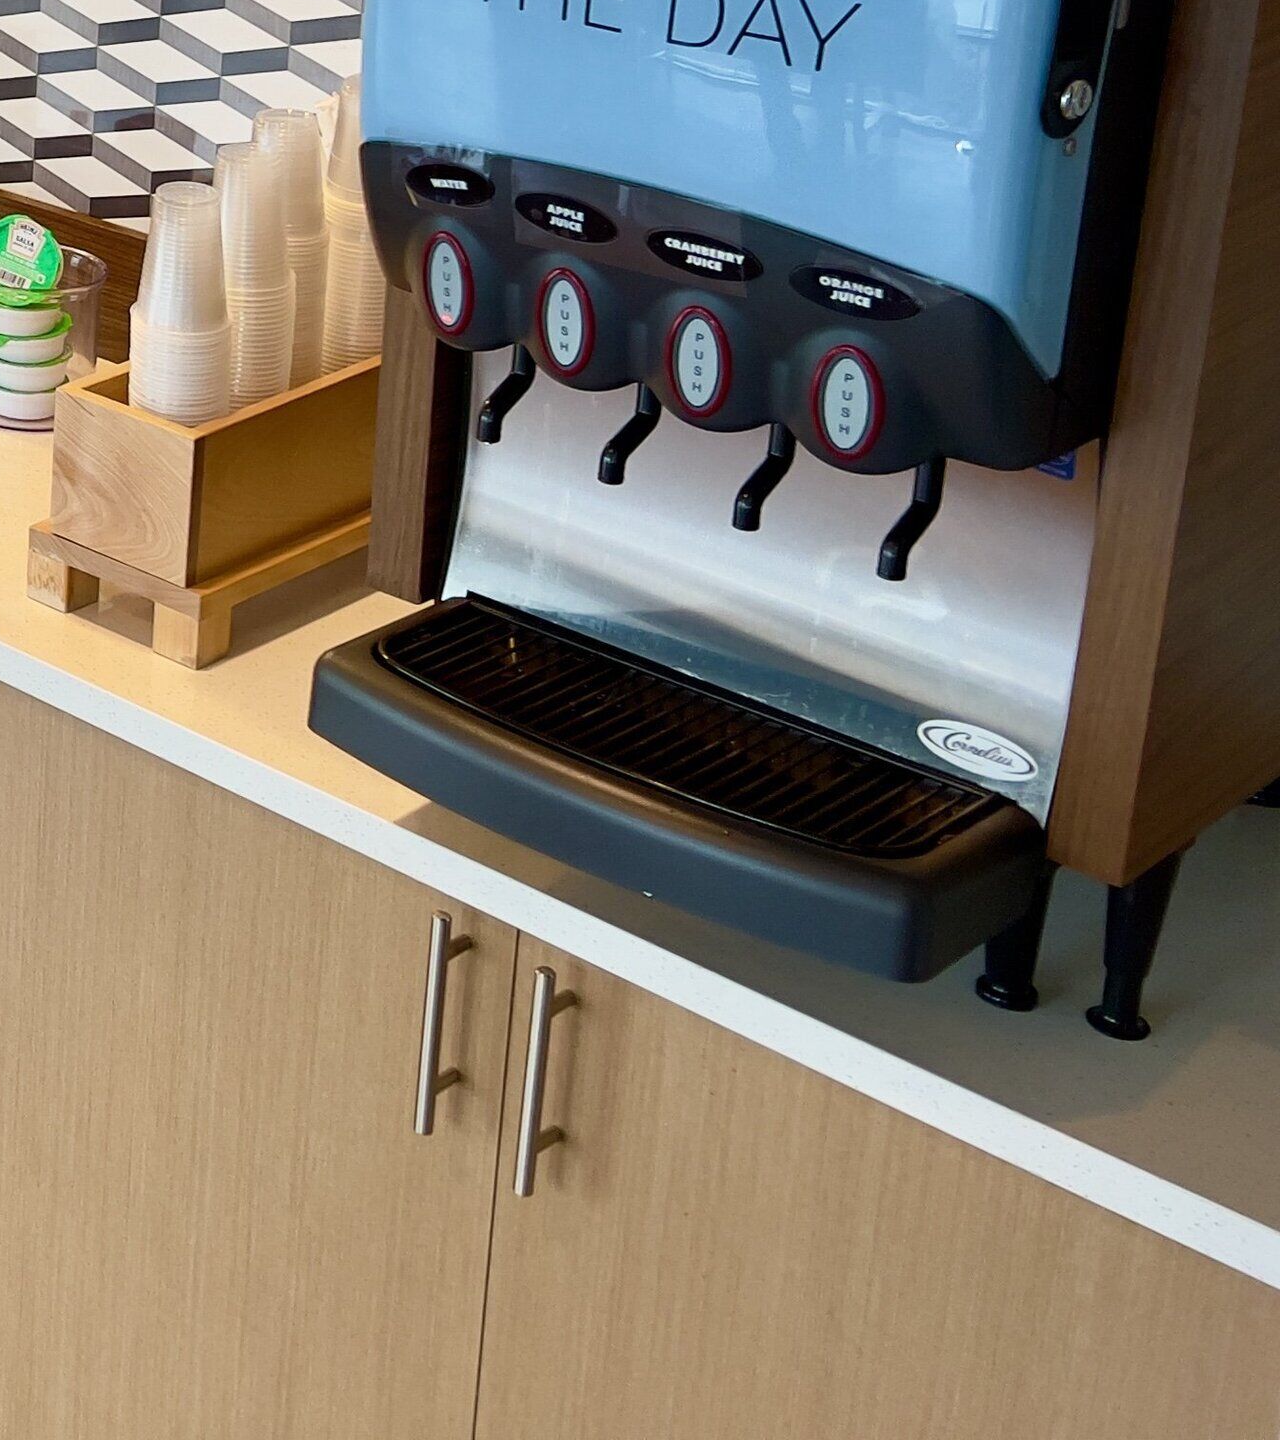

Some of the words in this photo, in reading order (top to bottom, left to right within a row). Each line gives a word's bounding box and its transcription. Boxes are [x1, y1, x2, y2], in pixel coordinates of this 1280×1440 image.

[429, 178, 468, 191] WATER
[546, 204, 585, 222] APPLE
[548, 216, 583, 233] JUICE
[664, 237, 744, 265] CRANBERRY
[685, 255, 723, 272] JUICE
[441, 256, 452, 312] PUSH
[818, 275, 884, 299] ORANGE
[830, 290, 871, 308] JUICE
[559, 293, 569, 352] PUSH
[692, 332, 705, 394] PUSH
[839, 373, 855, 436] PUSH
[942, 731, 1015, 769] Cornelius
